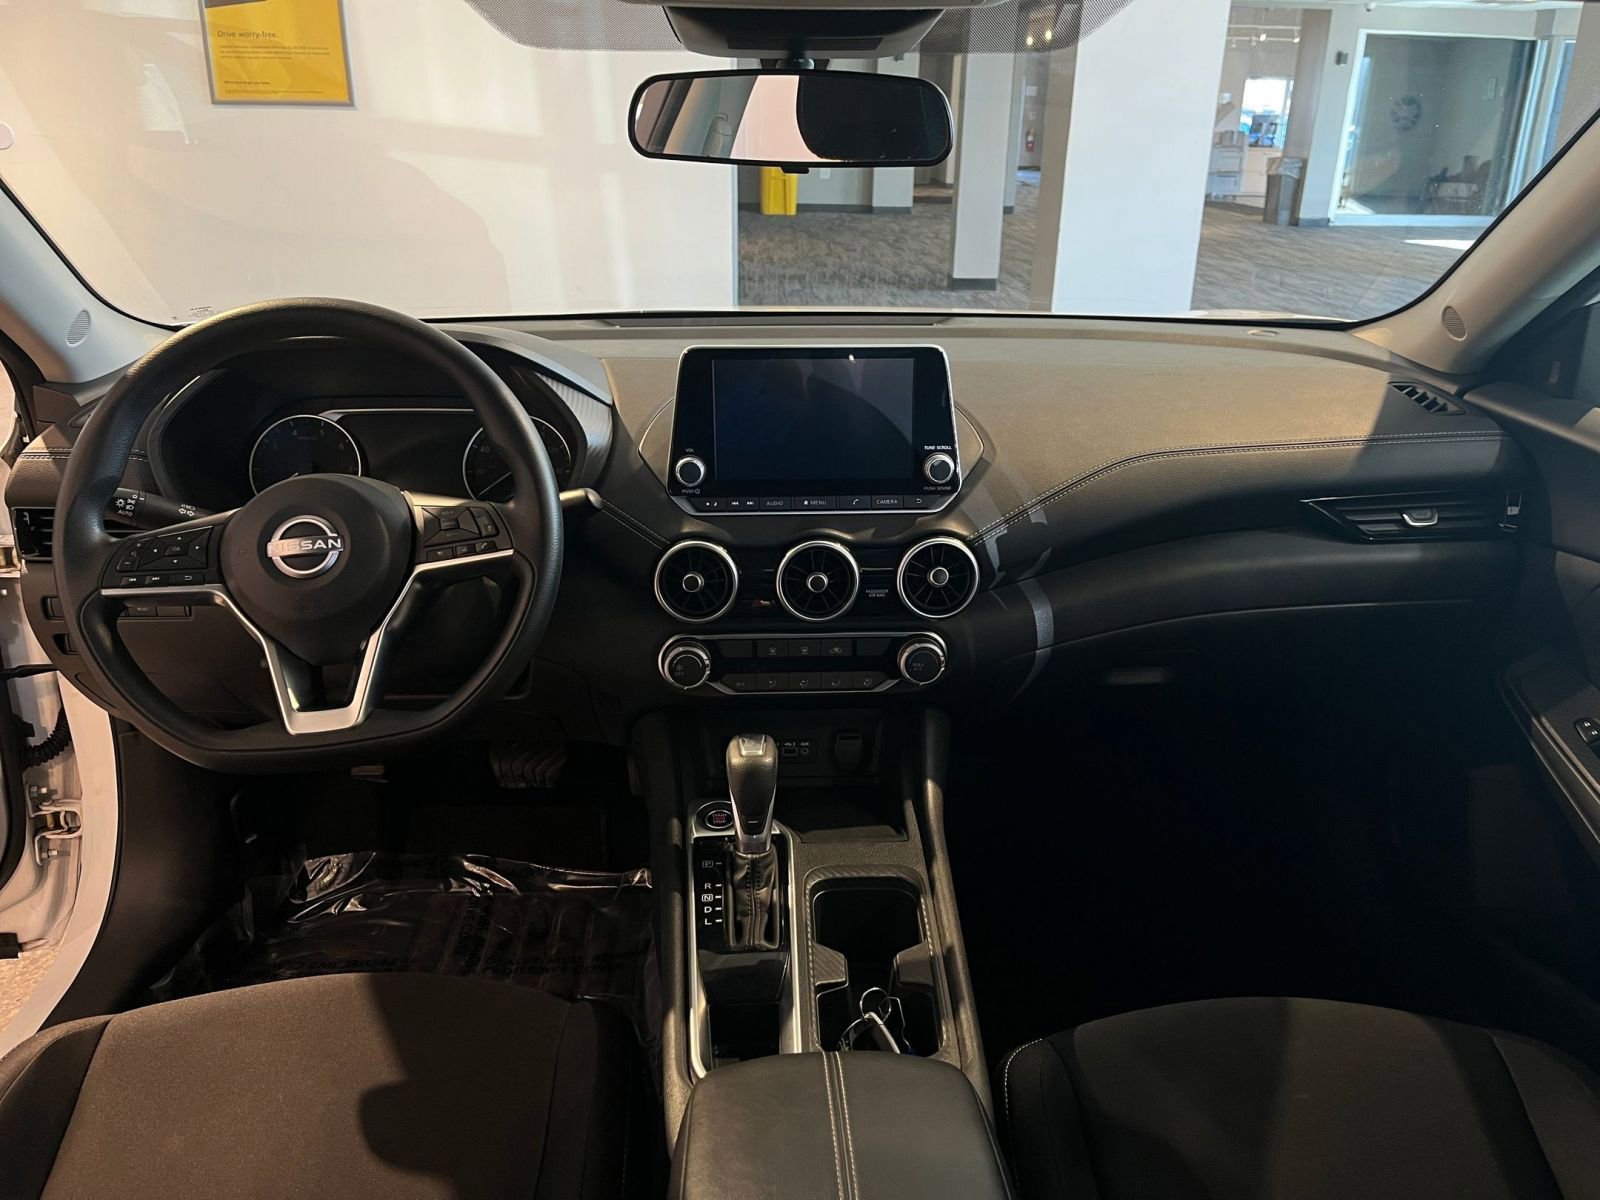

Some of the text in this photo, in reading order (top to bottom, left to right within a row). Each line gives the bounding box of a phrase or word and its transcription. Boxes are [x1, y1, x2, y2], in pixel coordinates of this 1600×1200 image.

[217, 30, 236, 38] Drive
[117, 509, 133, 517] AUTO
[272, 538, 342, 554] NISSAN
